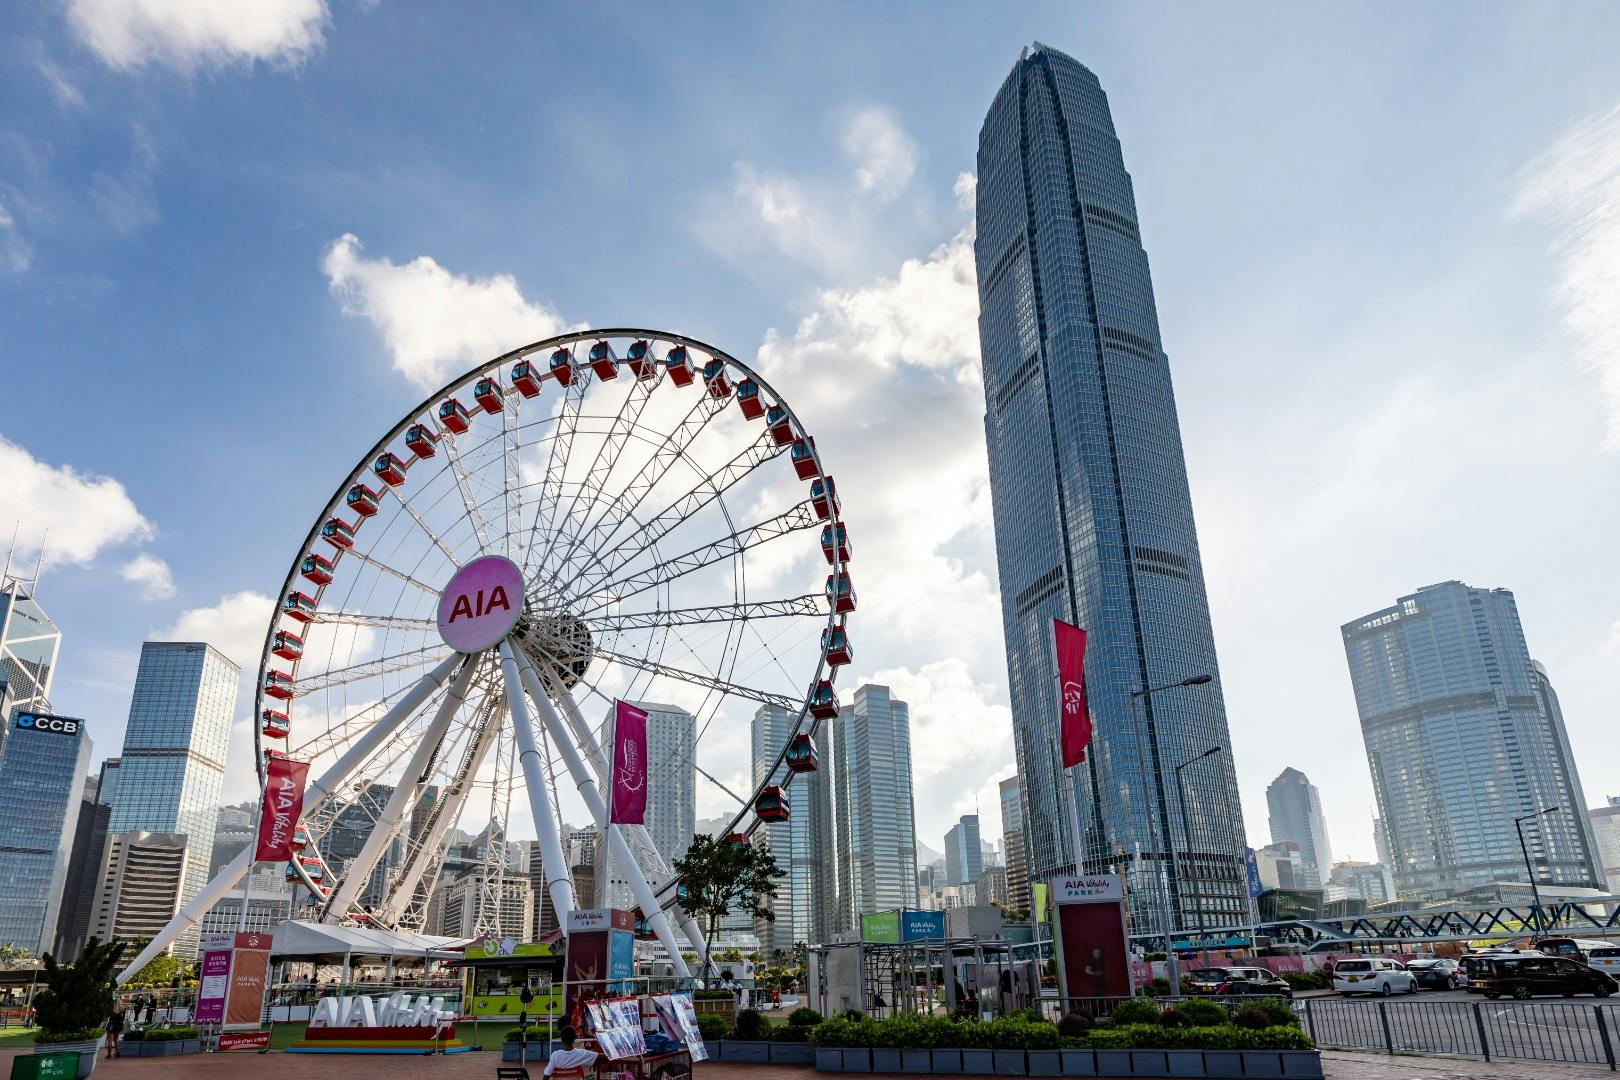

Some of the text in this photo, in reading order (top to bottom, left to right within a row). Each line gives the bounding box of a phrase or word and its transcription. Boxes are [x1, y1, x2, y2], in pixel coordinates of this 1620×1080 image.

[448, 585, 511, 623] AIA
[35, 717, 77, 733] CCB
[265, 776, 296, 849] AIA Vitality
[1065, 878, 1110, 889] AIA Vitality
[308, 995, 378, 1028] AIA
